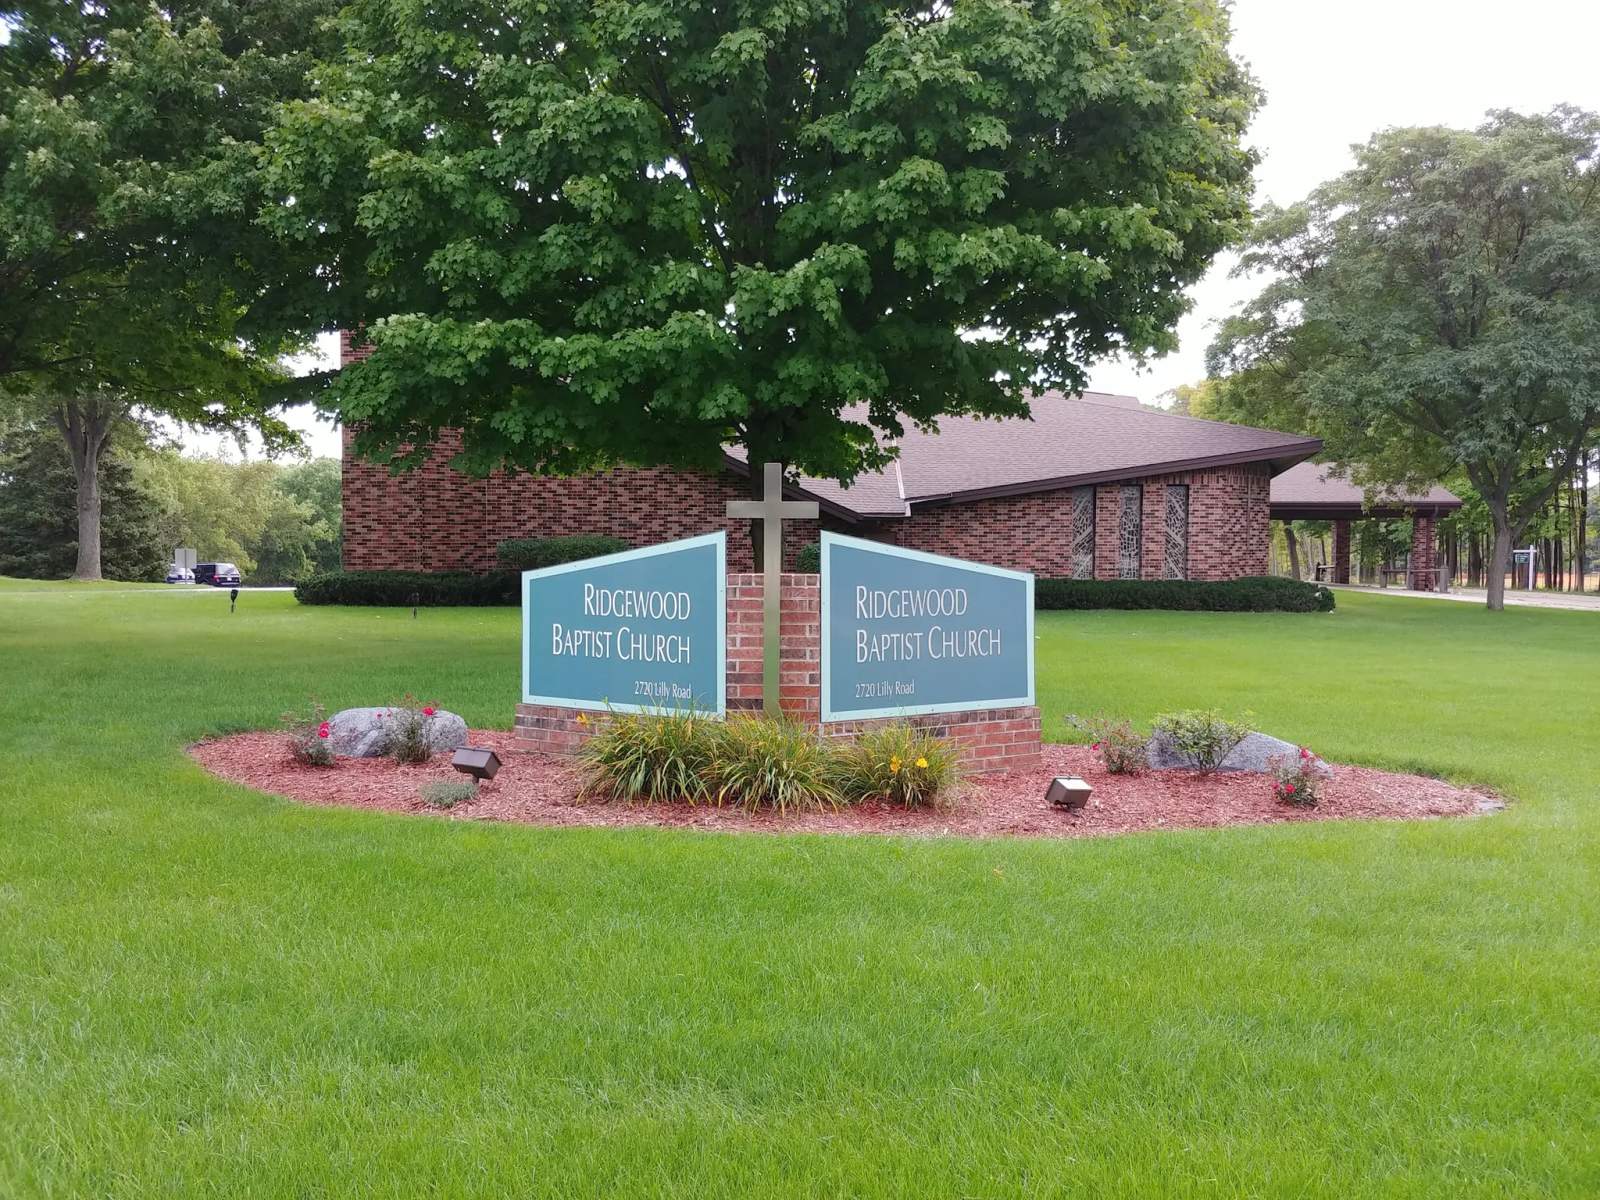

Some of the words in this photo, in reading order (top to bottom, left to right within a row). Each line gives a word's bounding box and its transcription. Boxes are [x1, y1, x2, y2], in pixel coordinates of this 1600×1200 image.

[584, 583, 691, 620] RIDGEWOOD
[855, 585, 968, 619] RIDGEWOOD
[552, 623, 613, 658] BAPTIST
[616, 627, 691, 664] CHURCH
[855, 629, 923, 663] BAPTIST
[928, 626, 1001, 660] CHURCH
[634, 680, 653, 696] 2720
[654, 681, 670, 701] Lilly
[672, 683, 692, 699] Road
[855, 682, 876, 698] 2720
[877, 680, 894, 701] Lilly
[895, 678, 915, 695] Road
